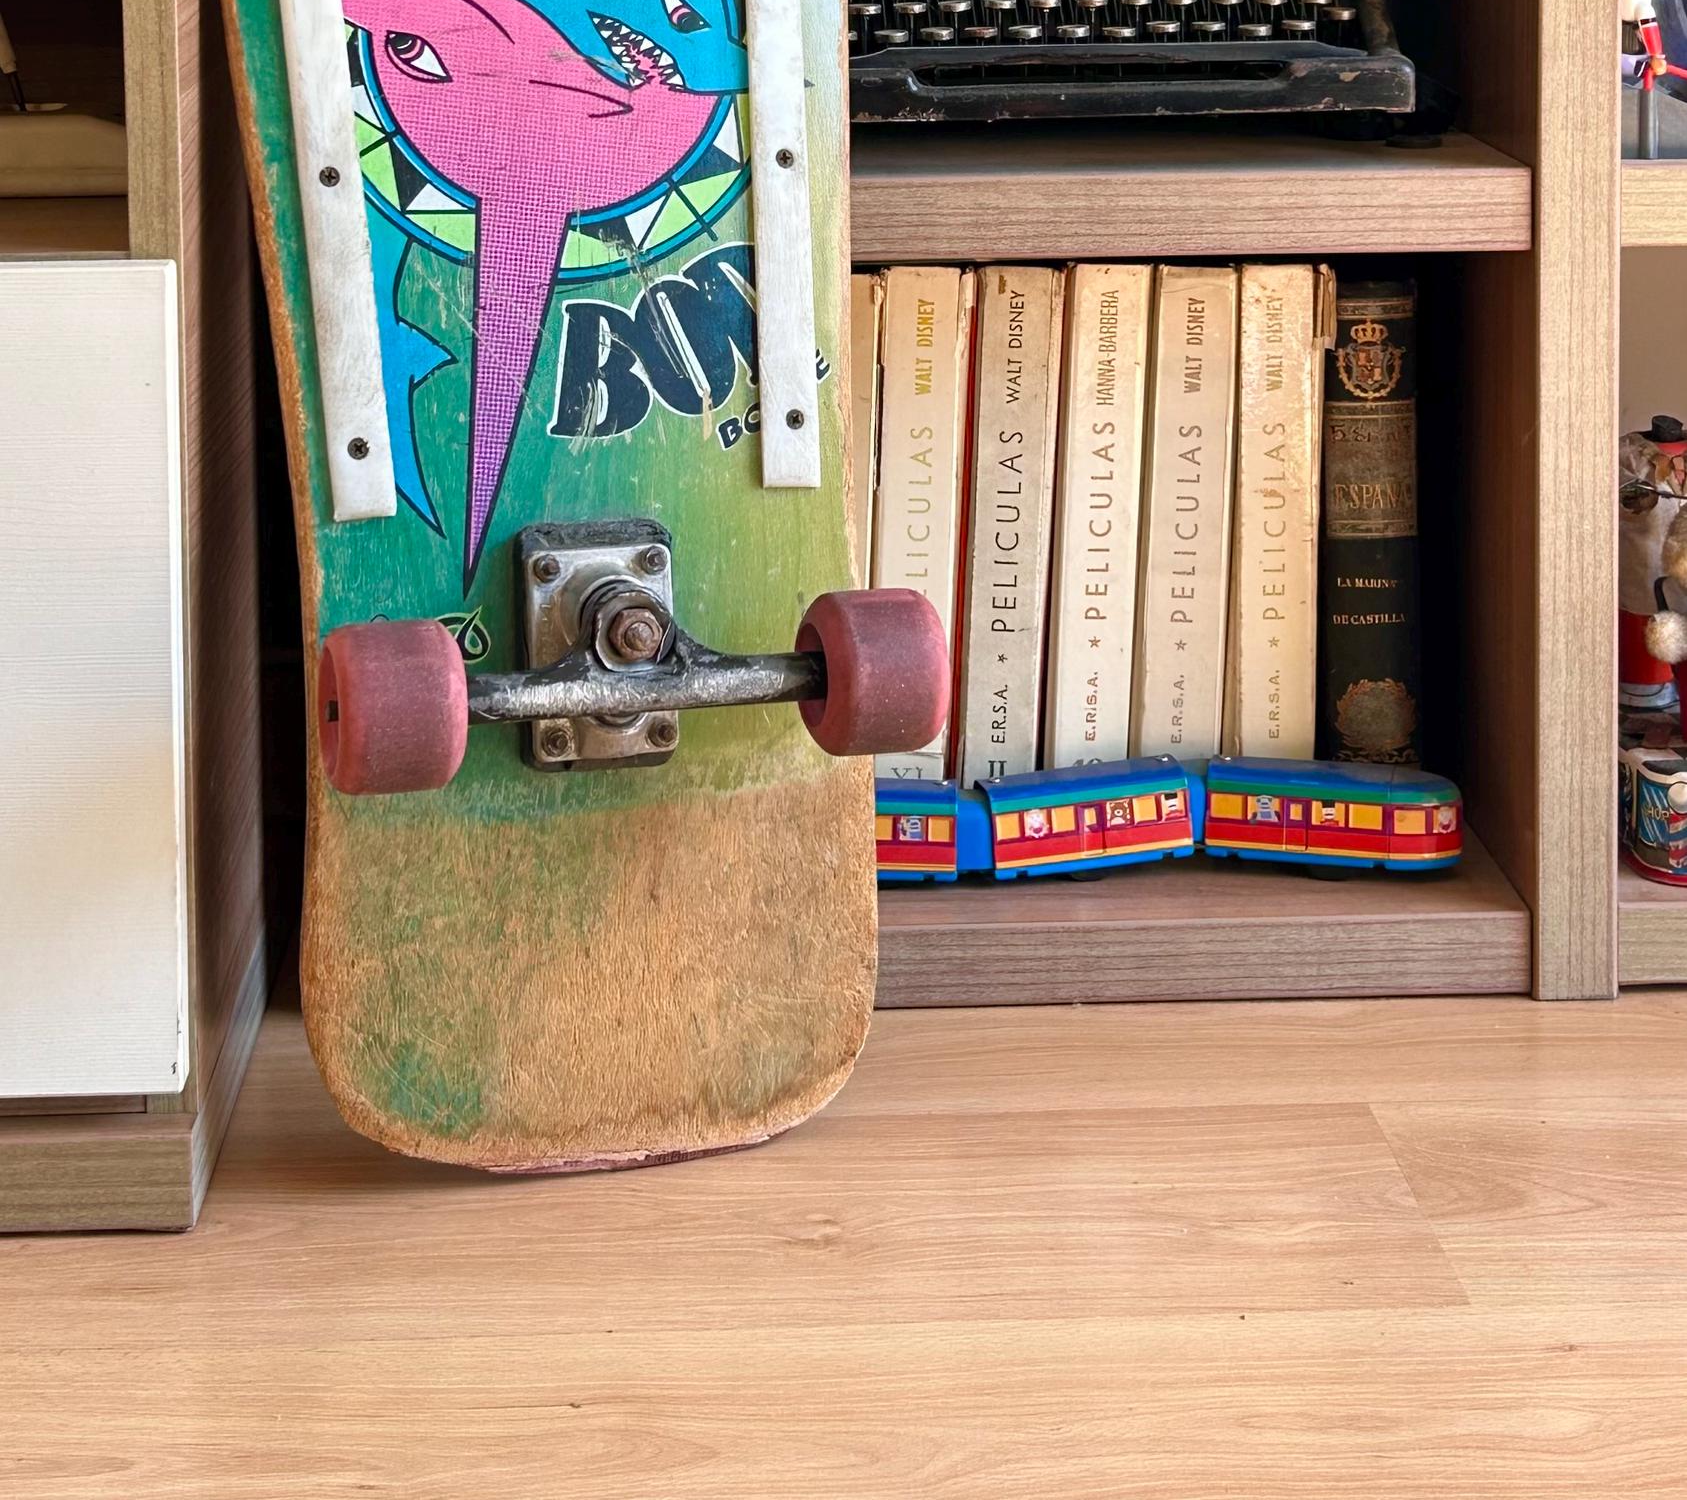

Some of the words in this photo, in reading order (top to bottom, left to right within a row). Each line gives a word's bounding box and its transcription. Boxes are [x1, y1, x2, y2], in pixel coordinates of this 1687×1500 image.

[916, 297, 936, 348] DISNEY
[1007, 289, 1026, 351] DISNEY
[1185, 297, 1206, 347] DISNEY
[1265, 292, 1284, 347] DISNEY
[1096, 288, 1119, 407] HANNA-BARBERA
[1184, 354, 1203, 394] WALT
[1265, 353, 1283, 393] WALT
[914, 355, 933, 397] WALT
[1005, 360, 1022, 405] WALT
[991, 429, 1024, 634] PELICULAS
[1084, 421, 1116, 621] PELICULAS
[1170, 423, 1203, 626] PELICULAS
[1263, 420, 1286, 621] PELICULAS
[1337, 576, 1352, 588] LA
[1332, 613, 1349, 625] DE
[1350, 612, 1406, 626] CASTILLA
[990, 684, 1008, 745] E.R.S.A.
[1171, 673, 1186, 745] E.R.S.A.
